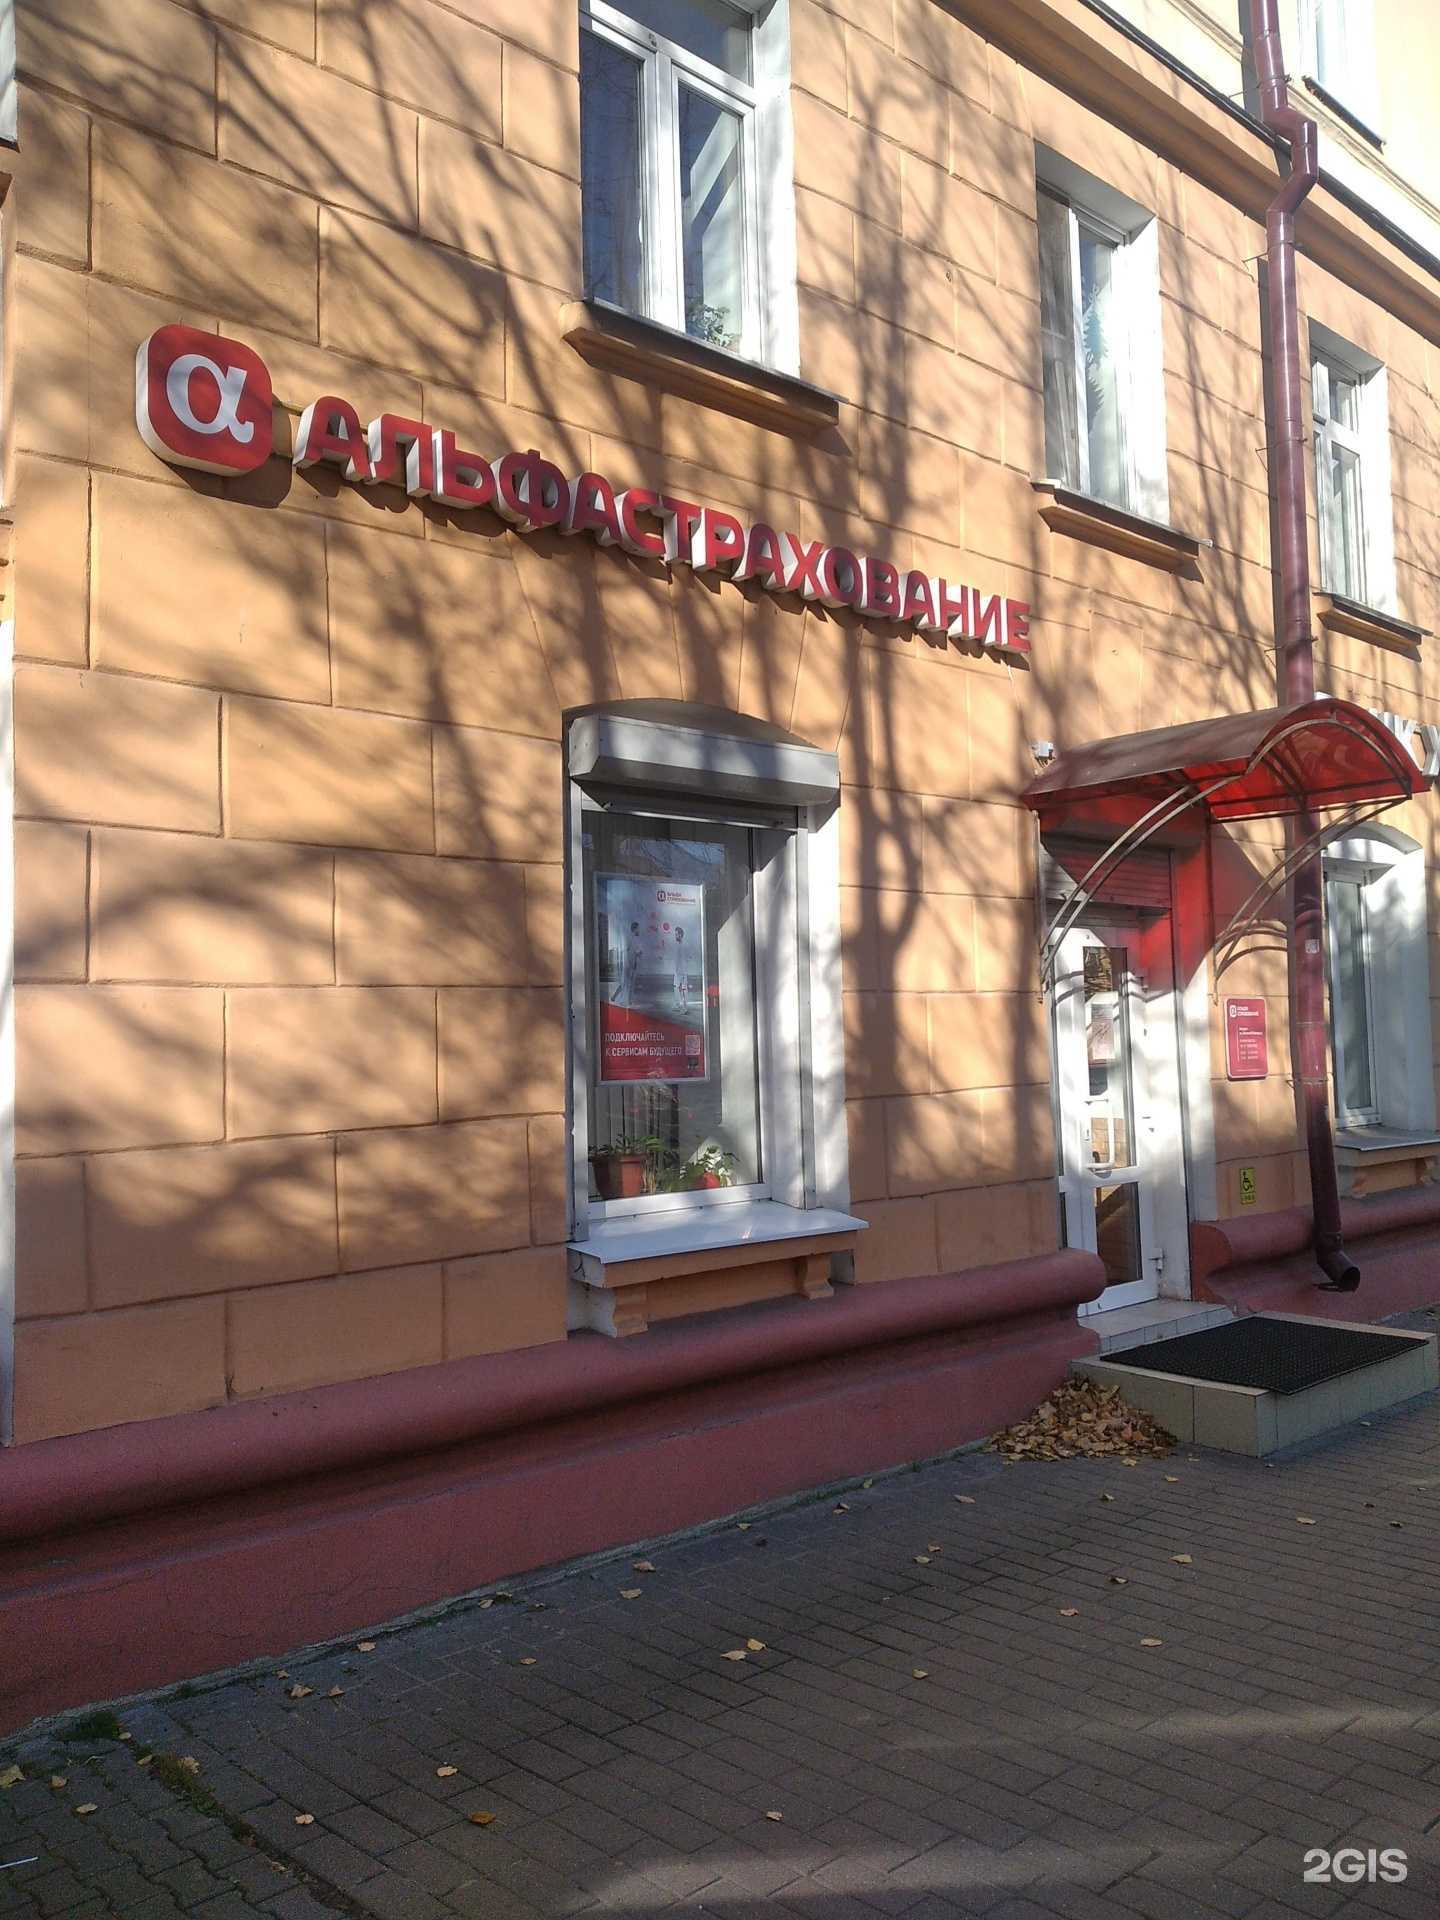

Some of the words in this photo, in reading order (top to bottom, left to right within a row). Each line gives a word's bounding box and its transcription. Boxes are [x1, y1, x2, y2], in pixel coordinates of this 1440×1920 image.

[293, 395, 1032, 654] АЛЬФАСТРАХОВАНИЕ
[605, 1031, 665, 1043] ПОДКЛЮЧАЙТЕСЬ
[611, 1047, 649, 1057] СЕРВИСАМ
[649, 1046, 682, 1057] БУДУЩЕГО
